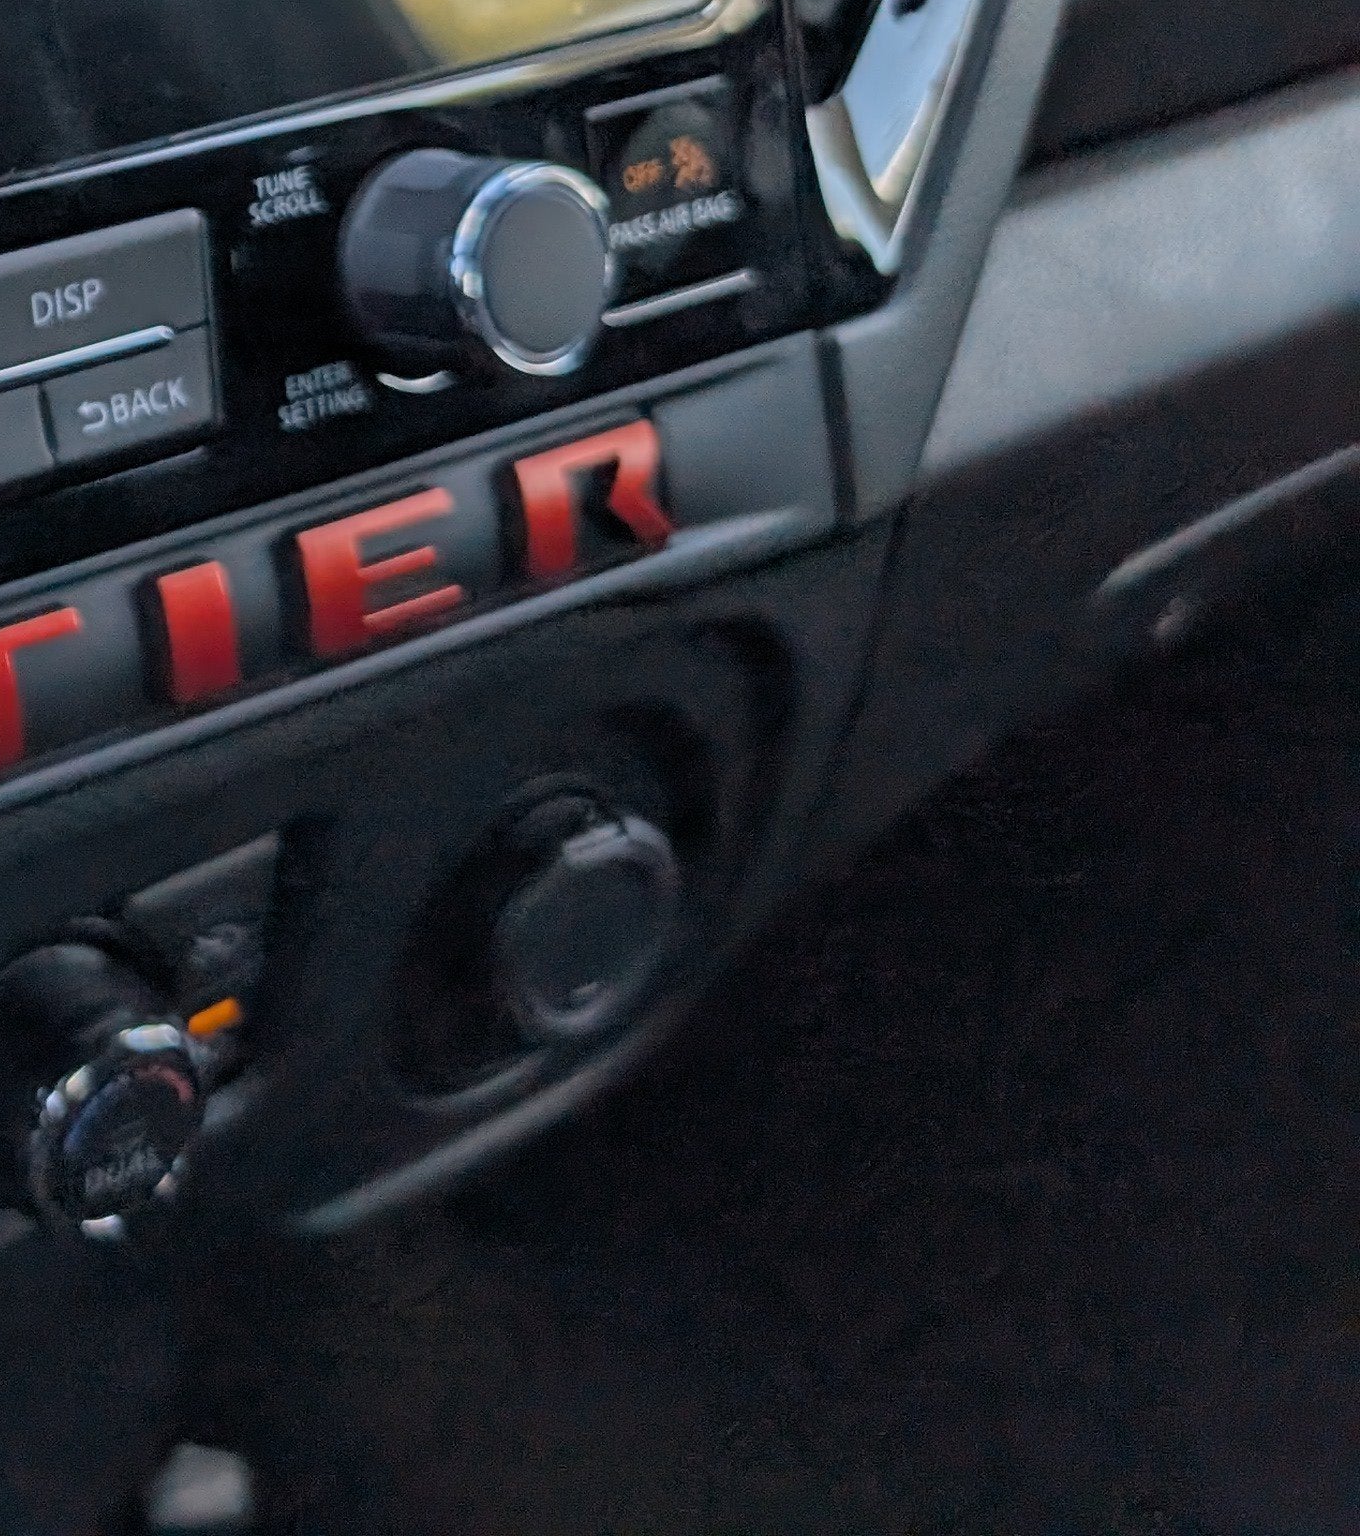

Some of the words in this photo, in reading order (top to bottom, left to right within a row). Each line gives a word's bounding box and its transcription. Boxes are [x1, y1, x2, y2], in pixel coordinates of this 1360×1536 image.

[254, 164, 311, 198] TUNE
[248, 187, 330, 227] SCROLL
[29, 277, 104, 329] DISP
[110, 374, 186, 426] BACK
